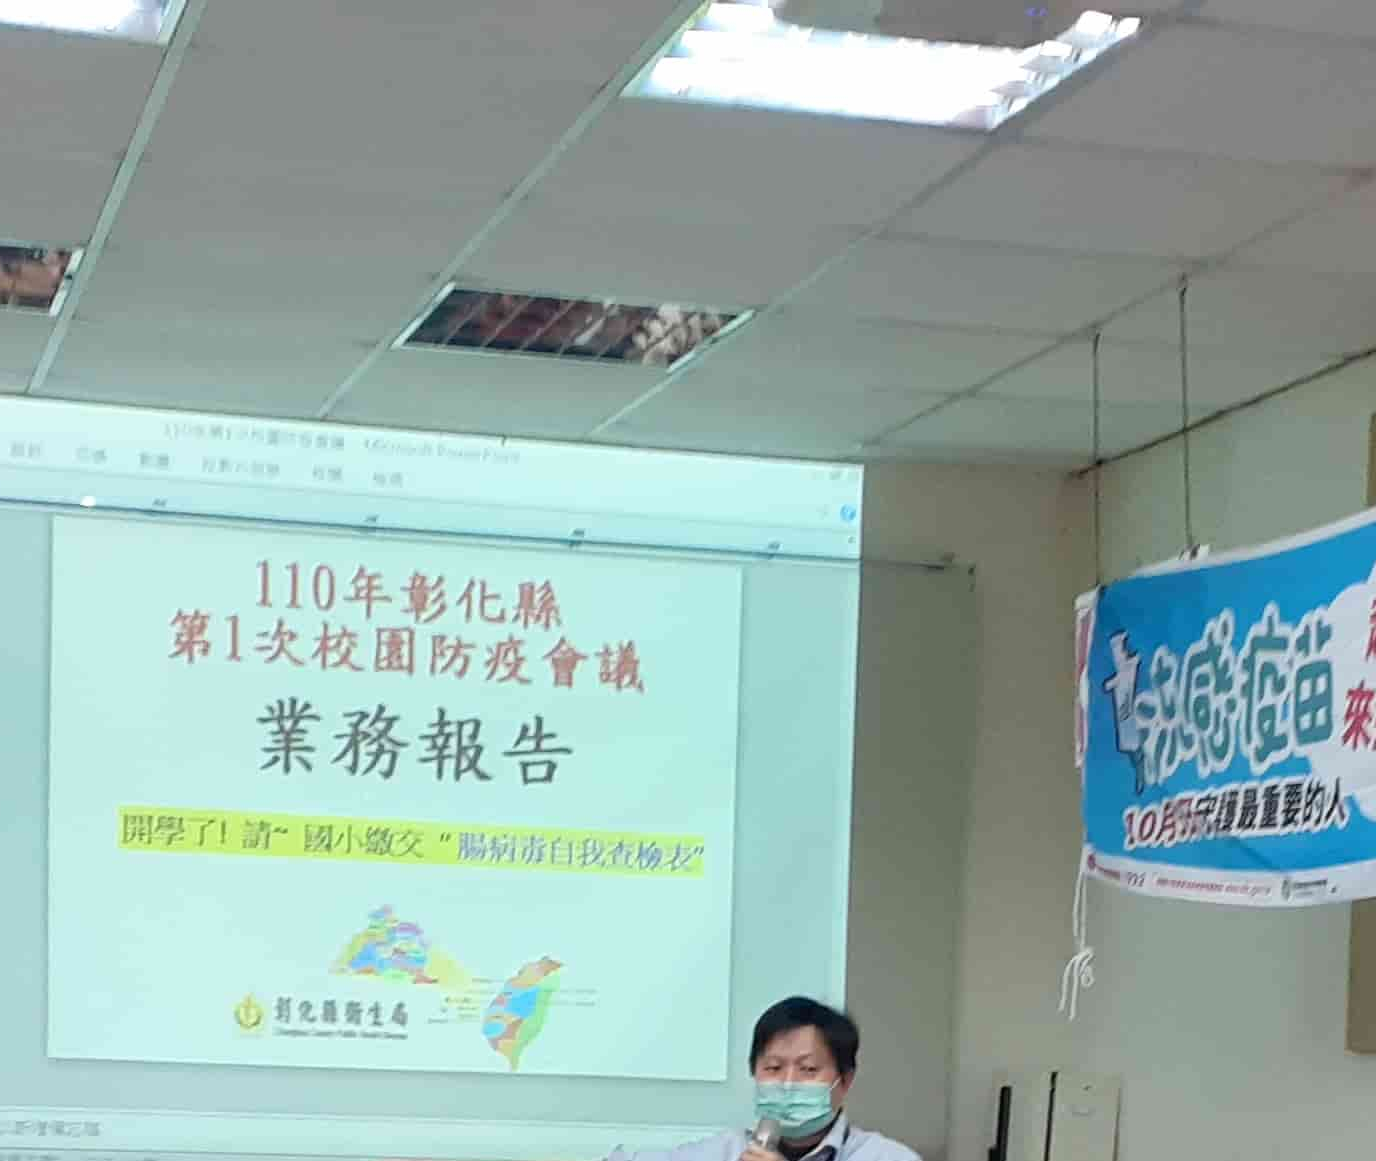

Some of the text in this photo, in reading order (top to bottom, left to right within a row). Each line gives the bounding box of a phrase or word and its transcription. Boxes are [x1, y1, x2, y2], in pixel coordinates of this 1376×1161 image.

[255, 558, 564, 629] 110年彰化縣
[168, 608, 645, 693] 第1次校園防疫會議
[256, 697, 574, 786] 業務報告
